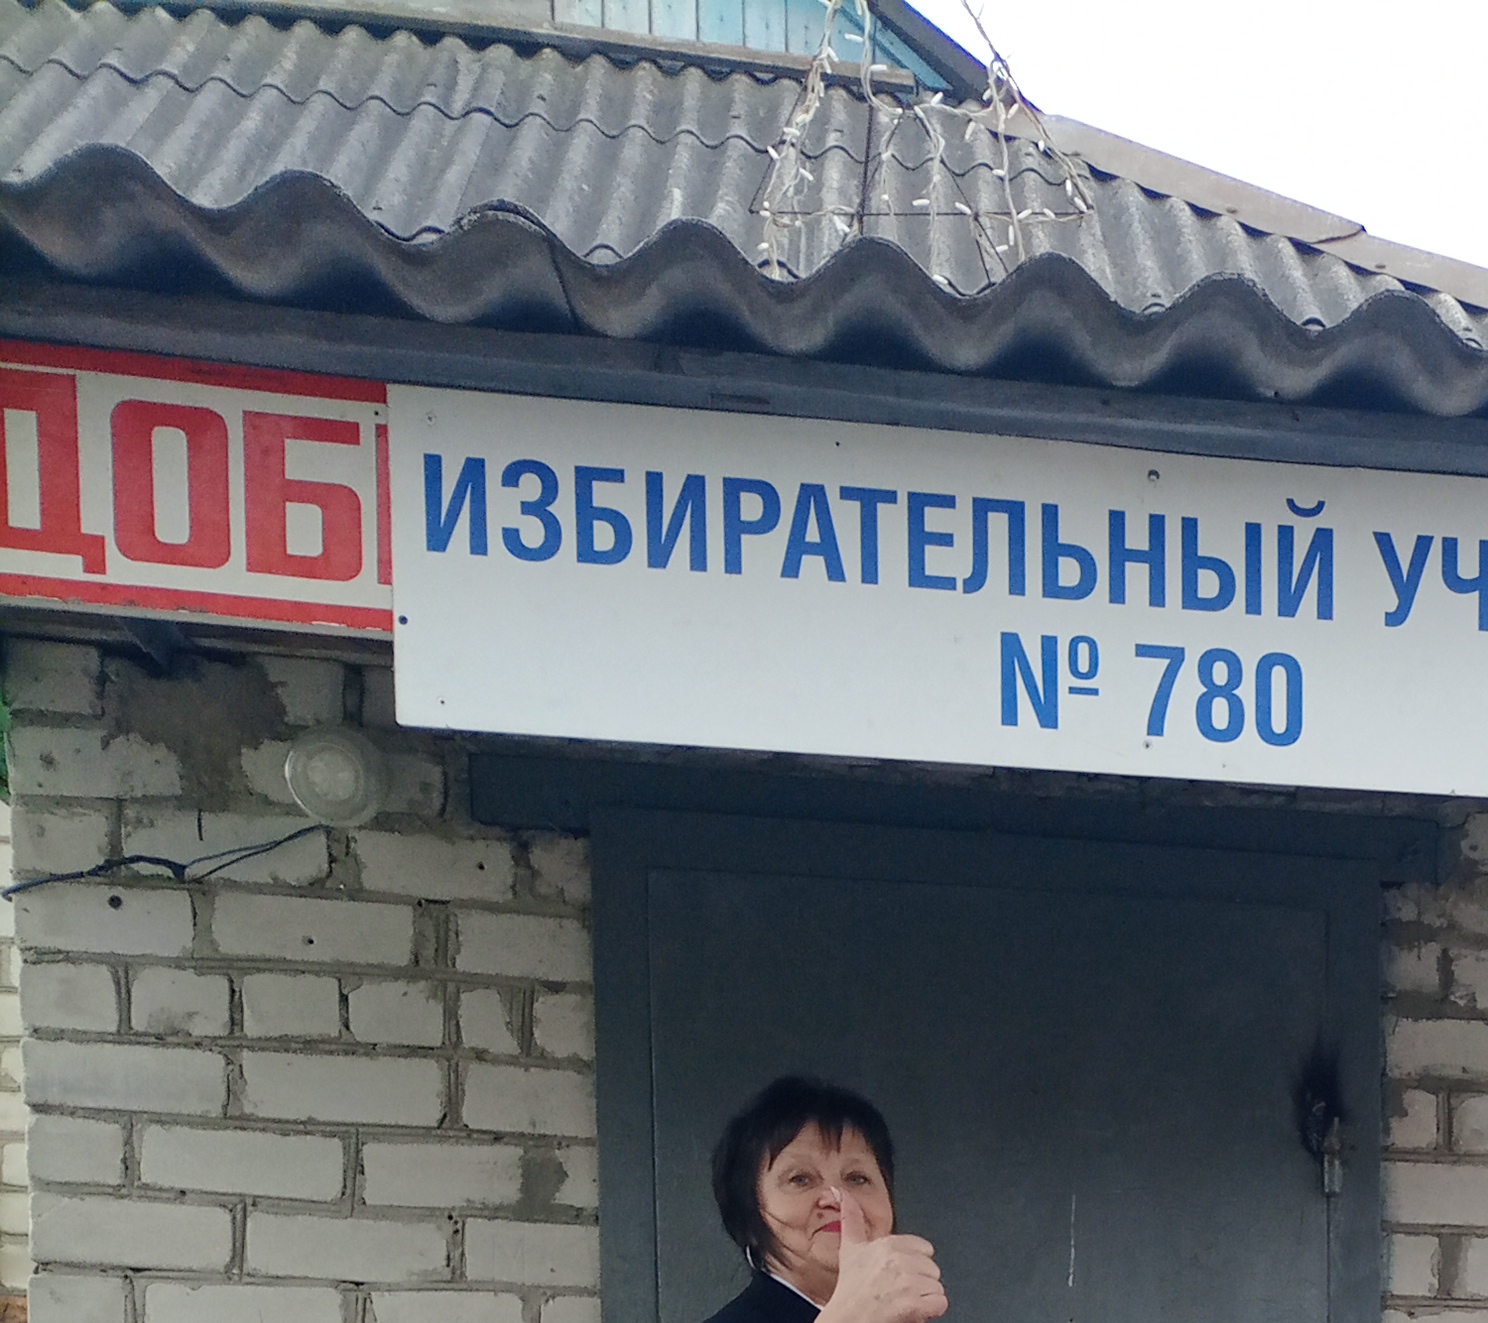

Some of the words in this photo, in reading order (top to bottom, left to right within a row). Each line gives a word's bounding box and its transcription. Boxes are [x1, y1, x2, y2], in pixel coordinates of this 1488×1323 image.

[0, 367, 394, 587] ДОБ
[425, 453, 1335, 621] ИЗБИРАТЕЛЬНЫЙ
[1001, 632, 1101, 730] №
[1136, 644, 1304, 747] 780
